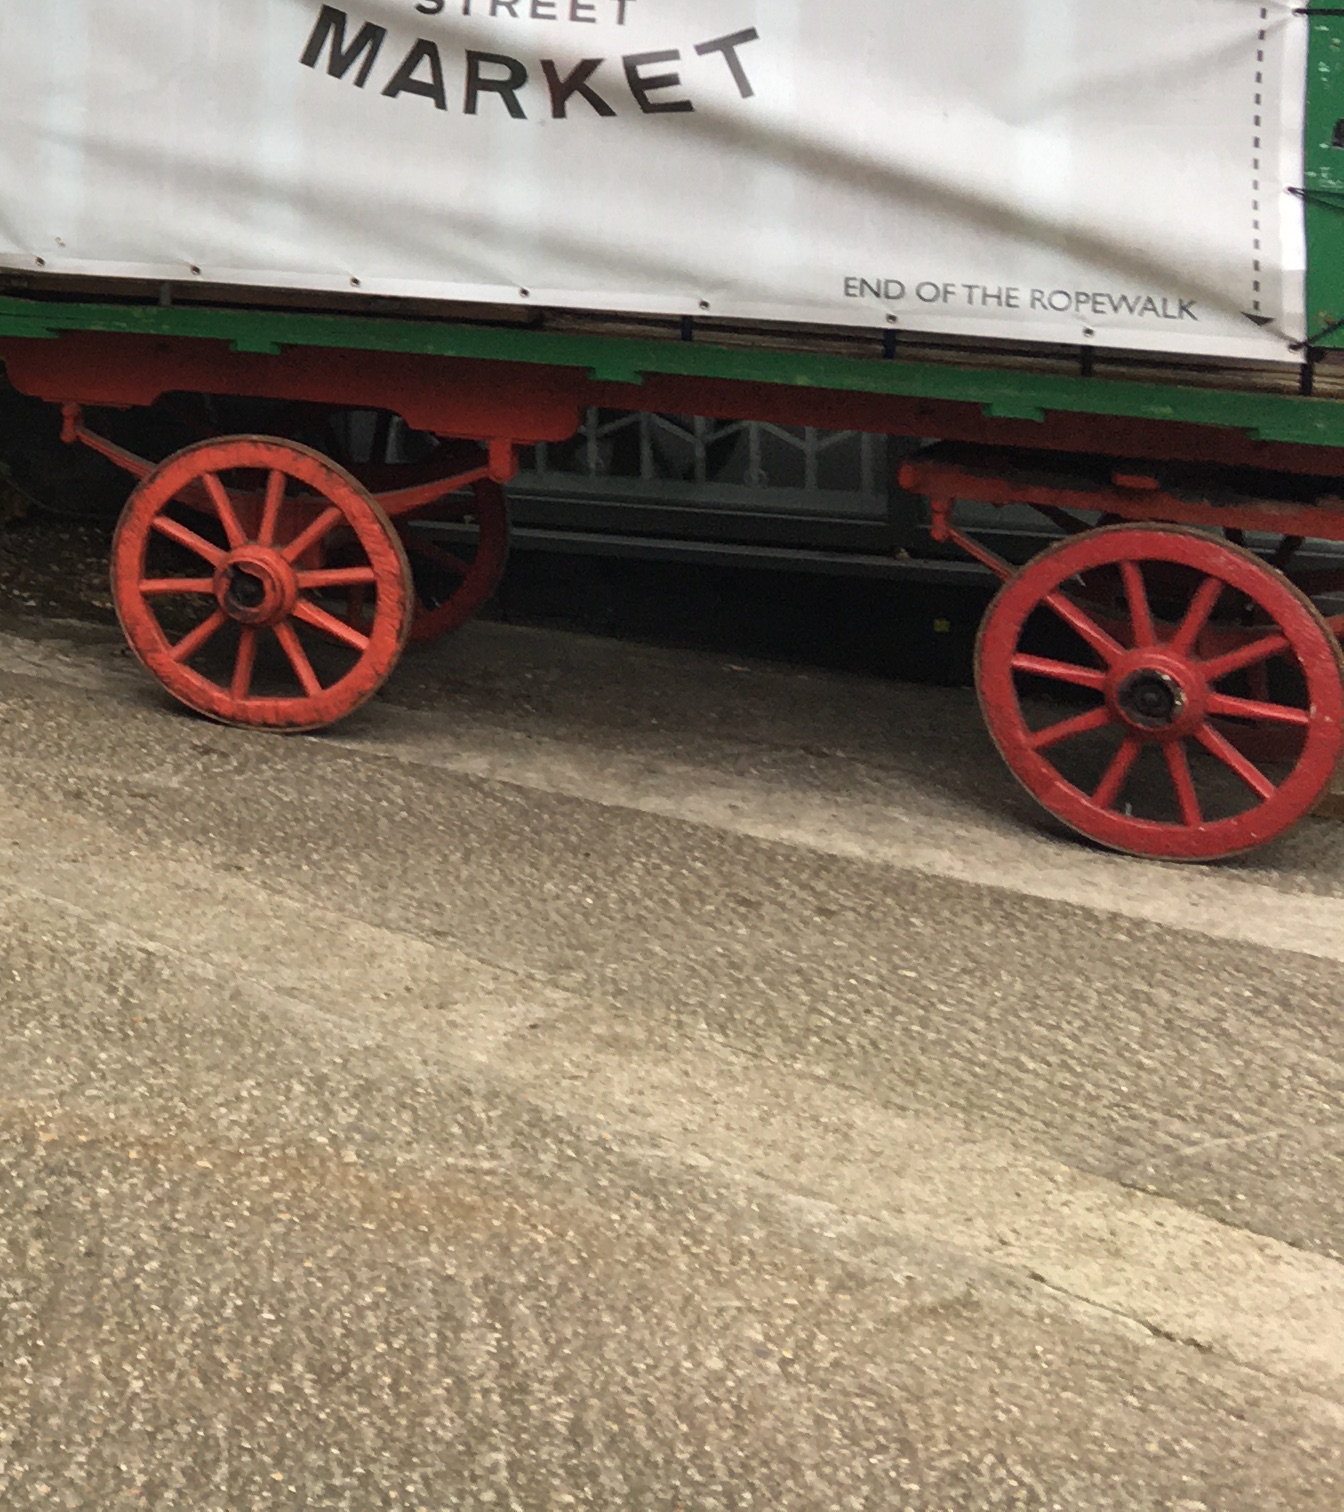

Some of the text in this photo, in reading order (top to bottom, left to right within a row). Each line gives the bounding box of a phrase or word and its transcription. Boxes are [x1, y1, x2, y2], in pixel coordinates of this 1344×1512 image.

[299, 2, 760, 120] MARKET
[842, 276, 1199, 322] END OF THE ROPEWALK
